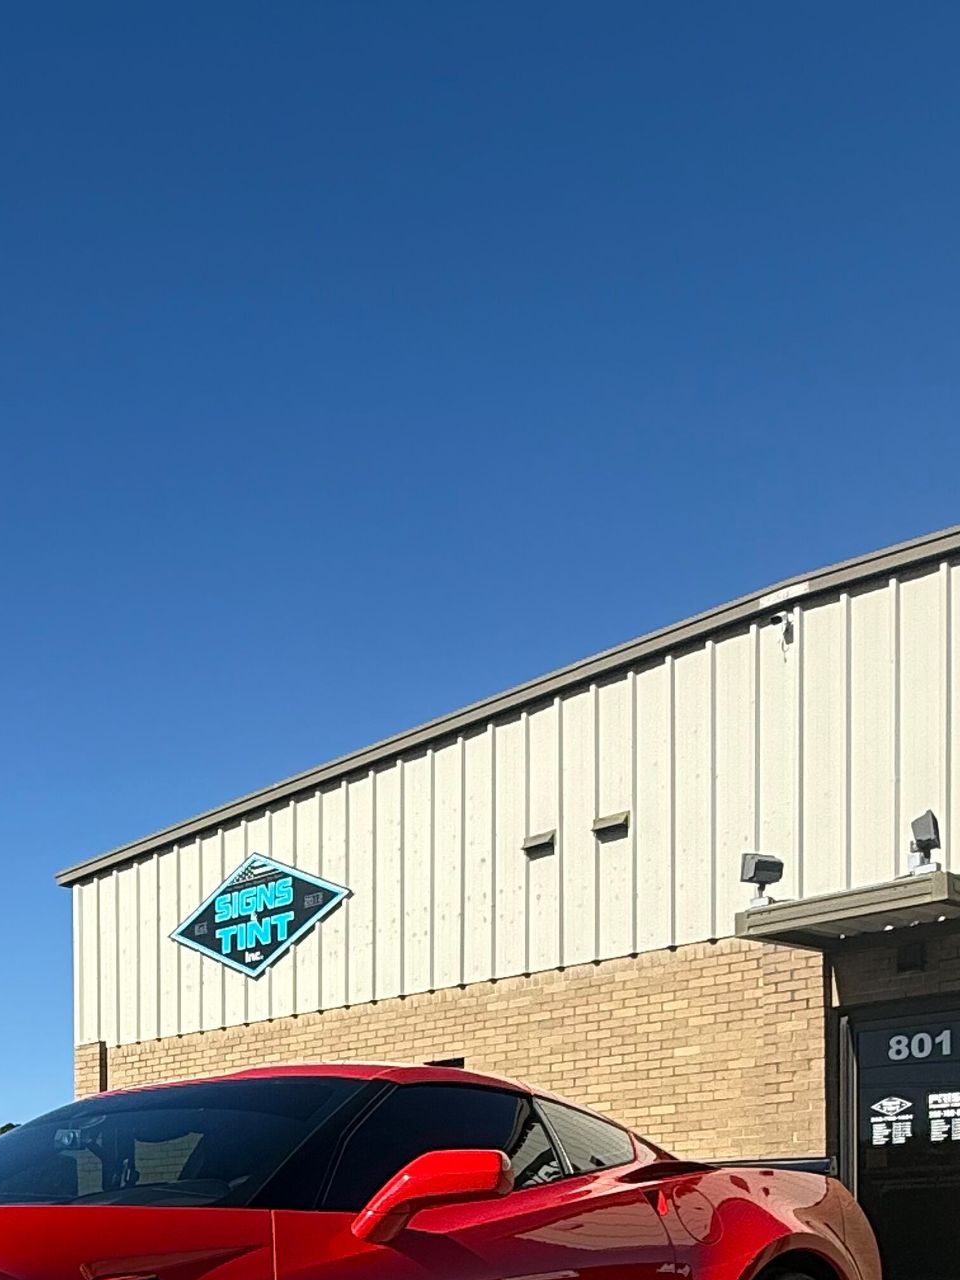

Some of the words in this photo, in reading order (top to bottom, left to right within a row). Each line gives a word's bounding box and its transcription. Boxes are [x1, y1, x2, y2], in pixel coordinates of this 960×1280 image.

[215, 878, 294, 923] SIGNS
[216, 912, 294, 956] TINT
[888, 1030, 951, 1061] 801
